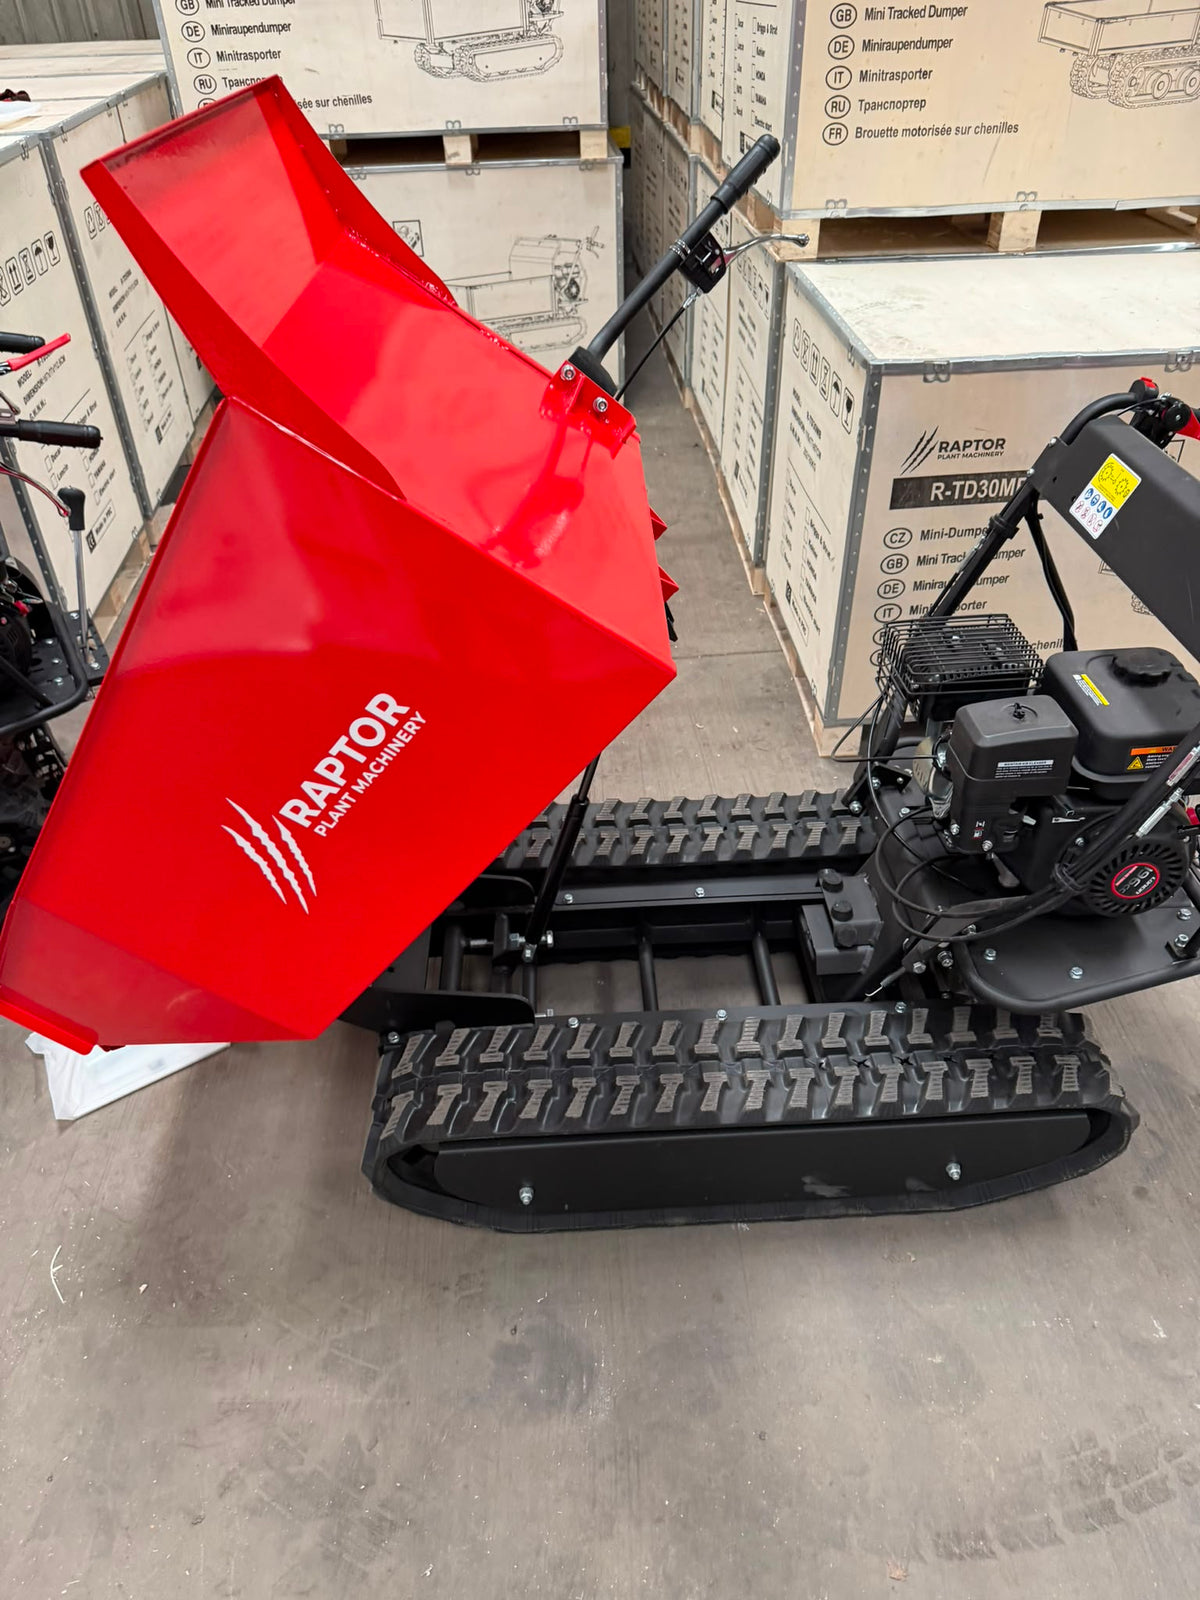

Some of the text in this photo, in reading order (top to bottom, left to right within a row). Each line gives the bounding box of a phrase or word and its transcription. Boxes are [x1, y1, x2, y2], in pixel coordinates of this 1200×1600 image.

[836, 4, 968, 22] GB Mini Tracked Dumper
[186, 21, 292, 37] DE Miniraupendumper
[834, 37, 953, 54] DE Miniraupendumper
[193, 48, 282, 64] IT Minitrasporter
[199, 78, 213, 90] RU
[833, 68, 933, 84] IT Minitrasporter
[315, 97, 330, 109] sur
[332, 93, 373, 108] chenilles
[830, 100, 846, 112] RU
[858, 98, 926, 114] Транспортер
[828, 122, 1019, 139] FR Brouette motorisée sur chenilles
[938, 438, 1006, 453] RAPTOR
[962, 450, 1004, 458] MACHINERY
[889, 526, 988, 544] CZ Mini-Dumpe
[886, 556, 902, 568] GB
[916, 554, 938, 566] Mini
[883, 583, 899, 594] DE
[882, 607, 892, 618] IT
[278, 693, 410, 828] RAPTOR
[313, 711, 427, 837] PLANT MACHINERY
